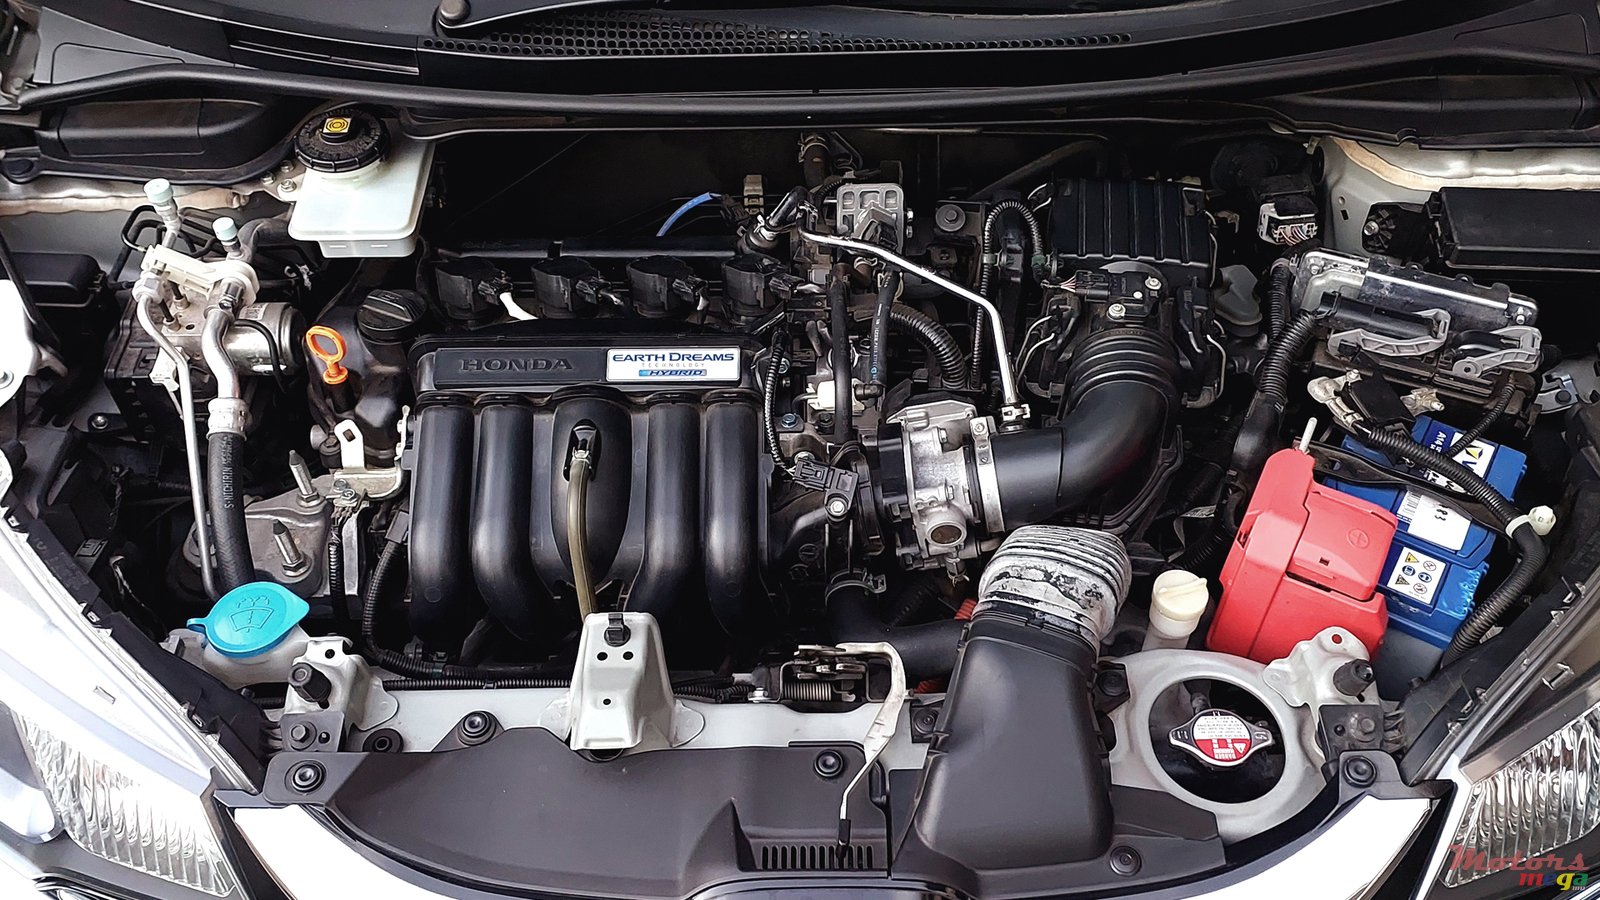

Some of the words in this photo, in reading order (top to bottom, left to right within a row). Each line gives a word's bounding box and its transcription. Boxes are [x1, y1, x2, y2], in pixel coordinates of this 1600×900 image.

[612, 353, 666, 364] EARTH
[669, 352, 735, 363] DREAMS
[460, 357, 575, 373] HONDA
[641, 361, 706, 369] TECHNOLOGY
[648, 369, 704, 377] HYBRID
